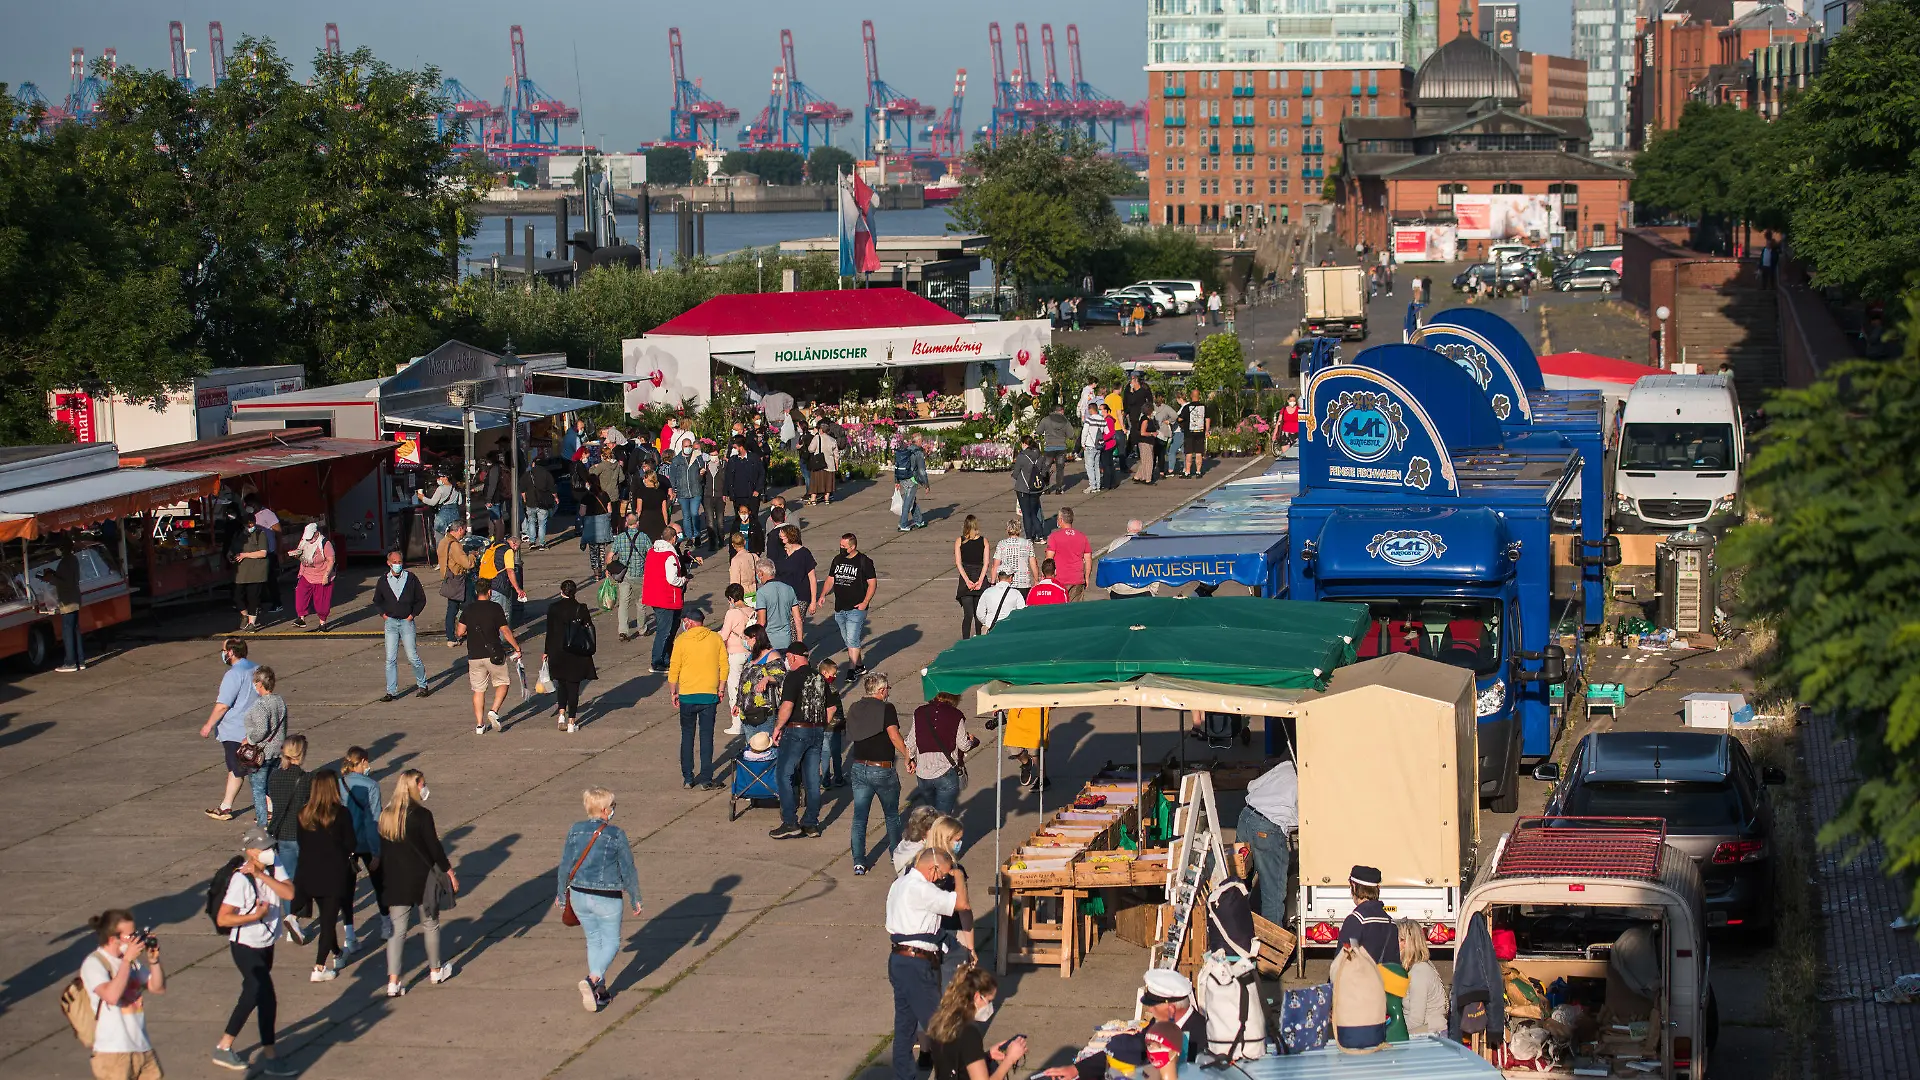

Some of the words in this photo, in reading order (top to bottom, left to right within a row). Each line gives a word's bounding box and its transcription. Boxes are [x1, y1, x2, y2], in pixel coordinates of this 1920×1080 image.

[1645, 33, 1654, 67] stilwerk
[911, 336, 983, 355] Blumenkönig
[775, 347, 867, 362] HOLLÄNDISCHER
[1329, 466, 1355, 477] FEINSTE
[1357, 467, 1402, 480] FISCHWAREN
[834, 564, 858, 576] DENIM
[1131, 561, 1236, 578] MATJESFILET
